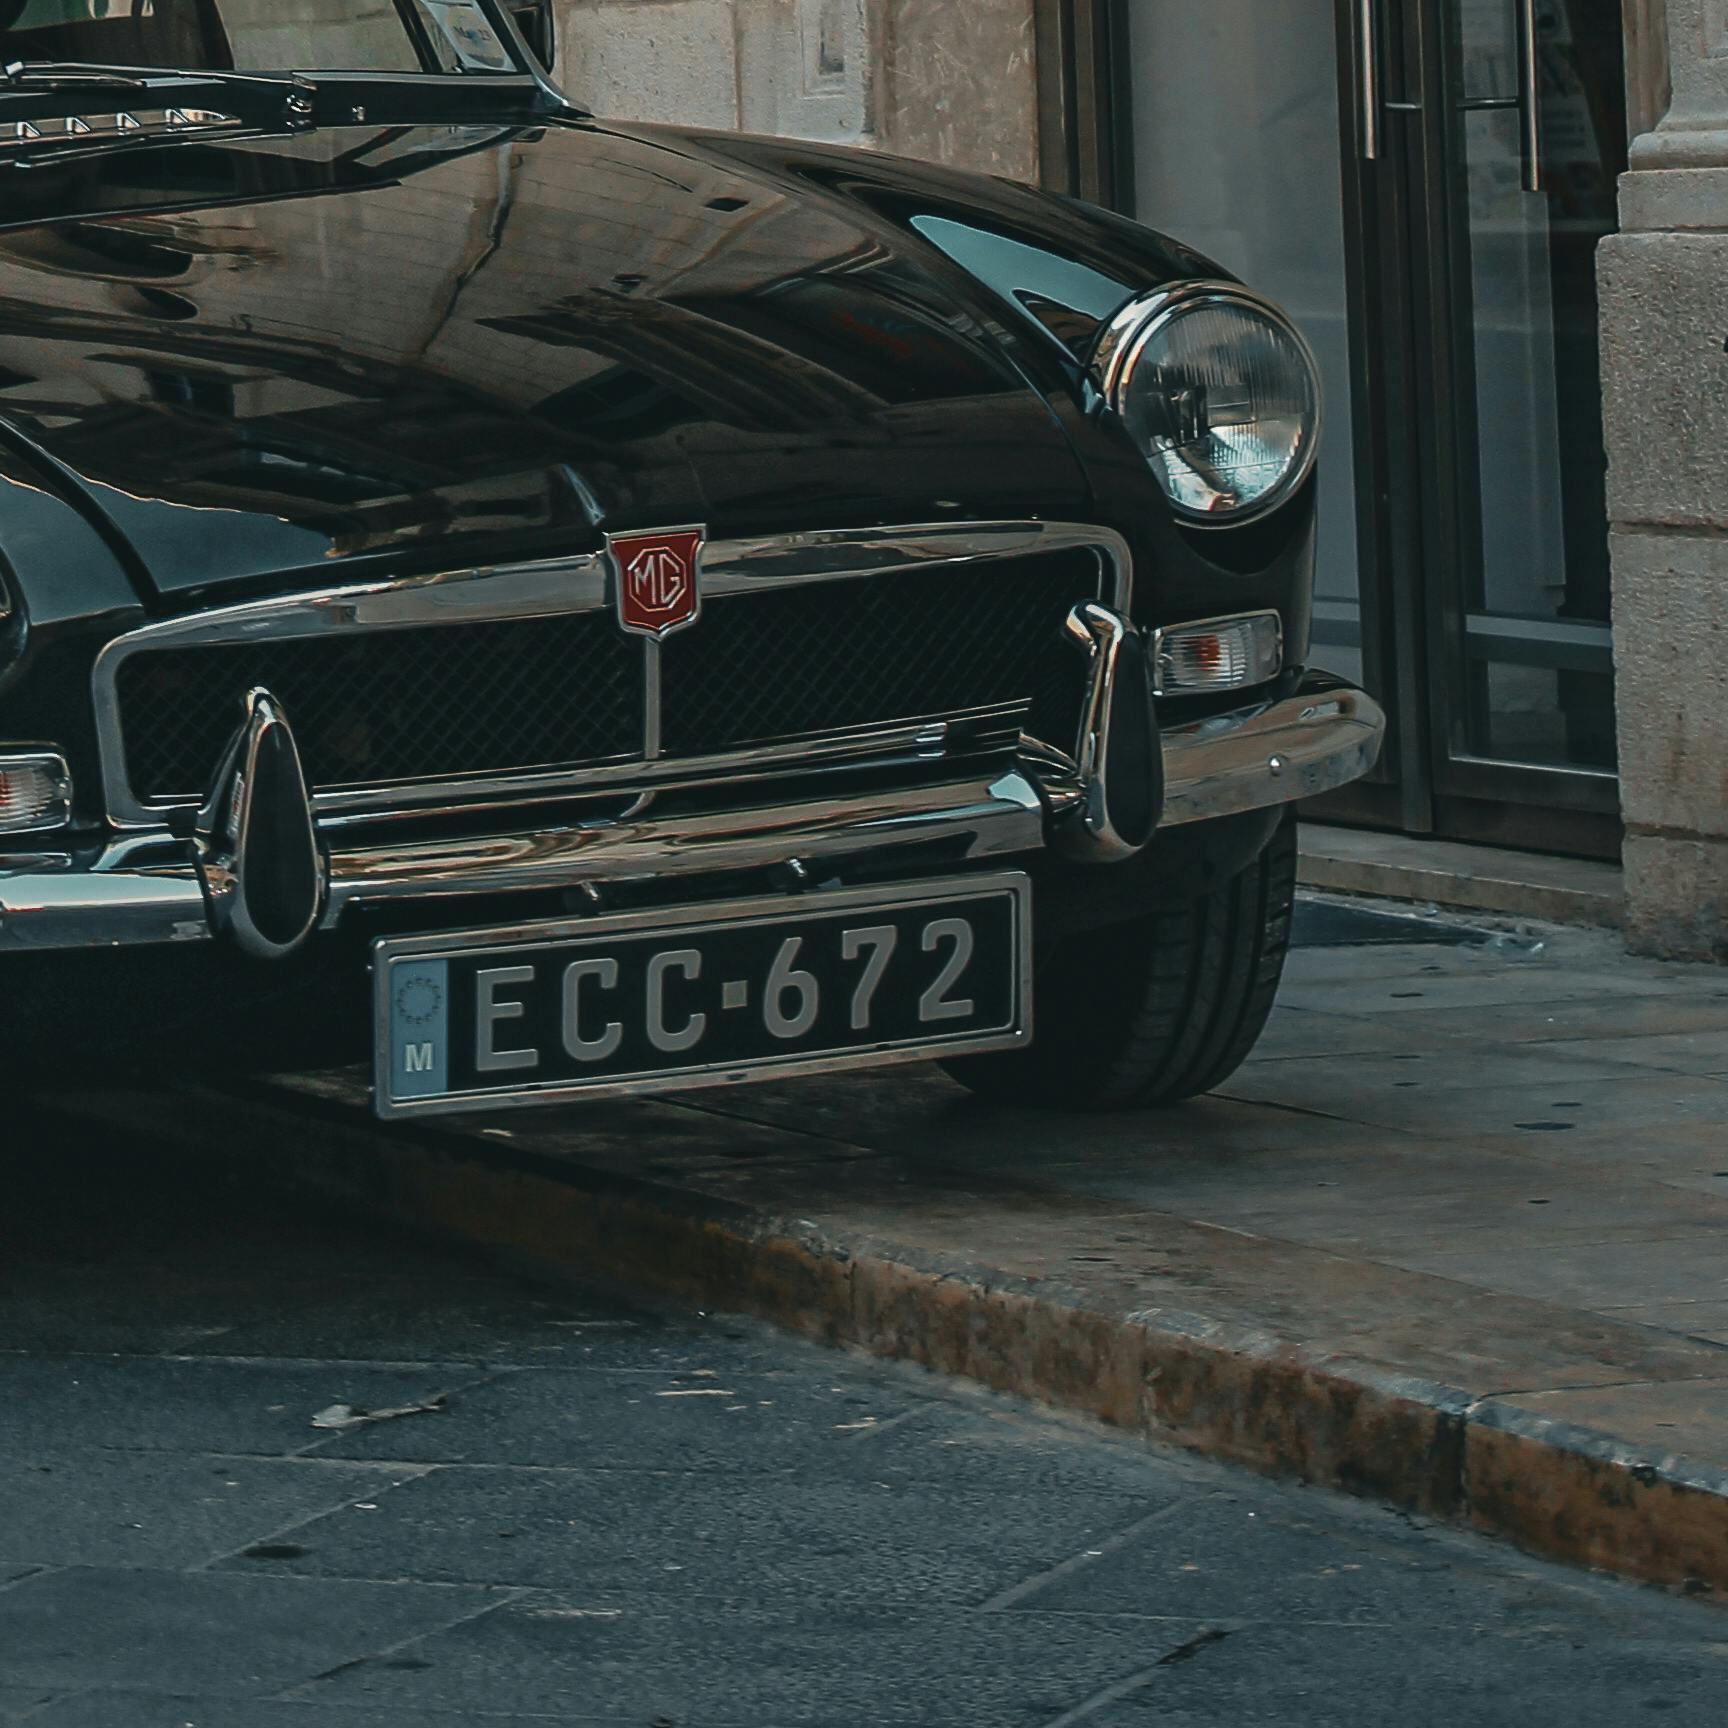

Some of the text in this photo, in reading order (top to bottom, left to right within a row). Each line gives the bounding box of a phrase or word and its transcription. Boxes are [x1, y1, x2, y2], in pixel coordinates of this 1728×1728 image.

[634, 553, 681, 605] MG
[475, 917, 974, 1072] ECC-672
[404, 1042, 434, 1072] M
